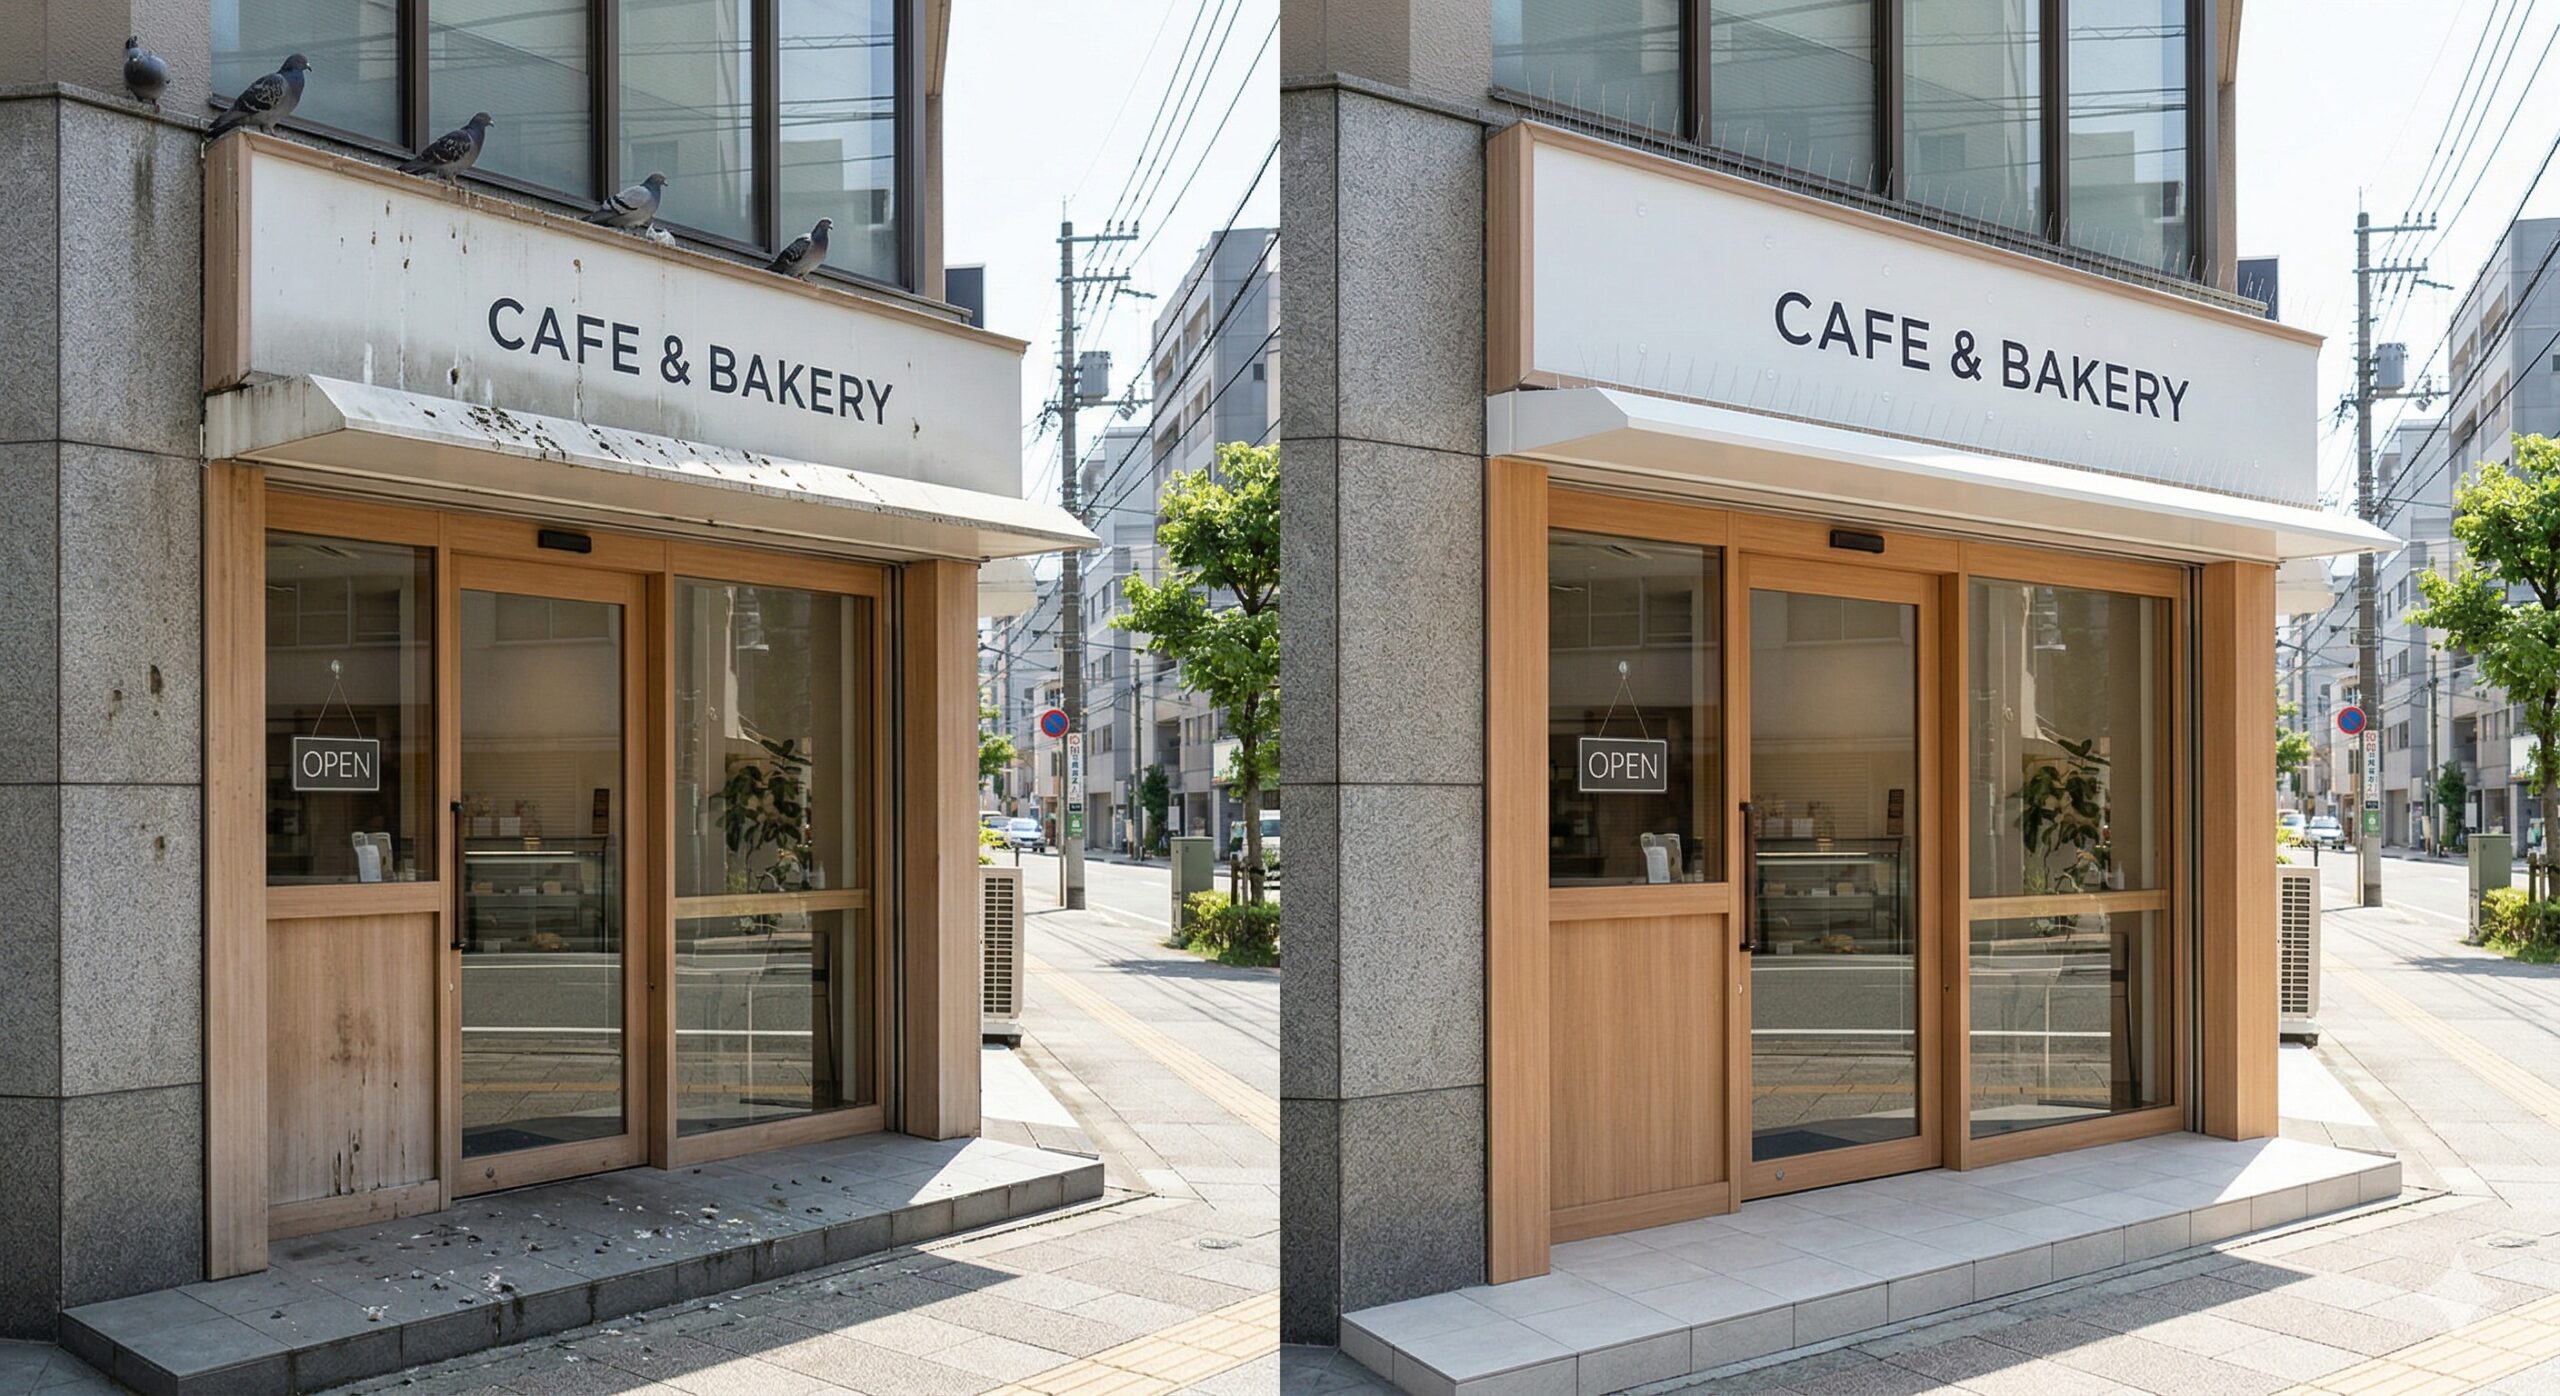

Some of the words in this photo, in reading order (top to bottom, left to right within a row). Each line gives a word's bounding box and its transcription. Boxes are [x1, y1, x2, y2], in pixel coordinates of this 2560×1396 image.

[488, 297, 640, 376] CAFE
[660, 334, 691, 386] &
[709, 344, 893, 425] BAKERY
[1775, 291, 1930, 372] CAFE
[1950, 330, 1982, 381] &
[2002, 339, 2189, 422] BAKERY
[302, 750, 370, 778] OPEN
[1588, 751, 1658, 780] OPEN
